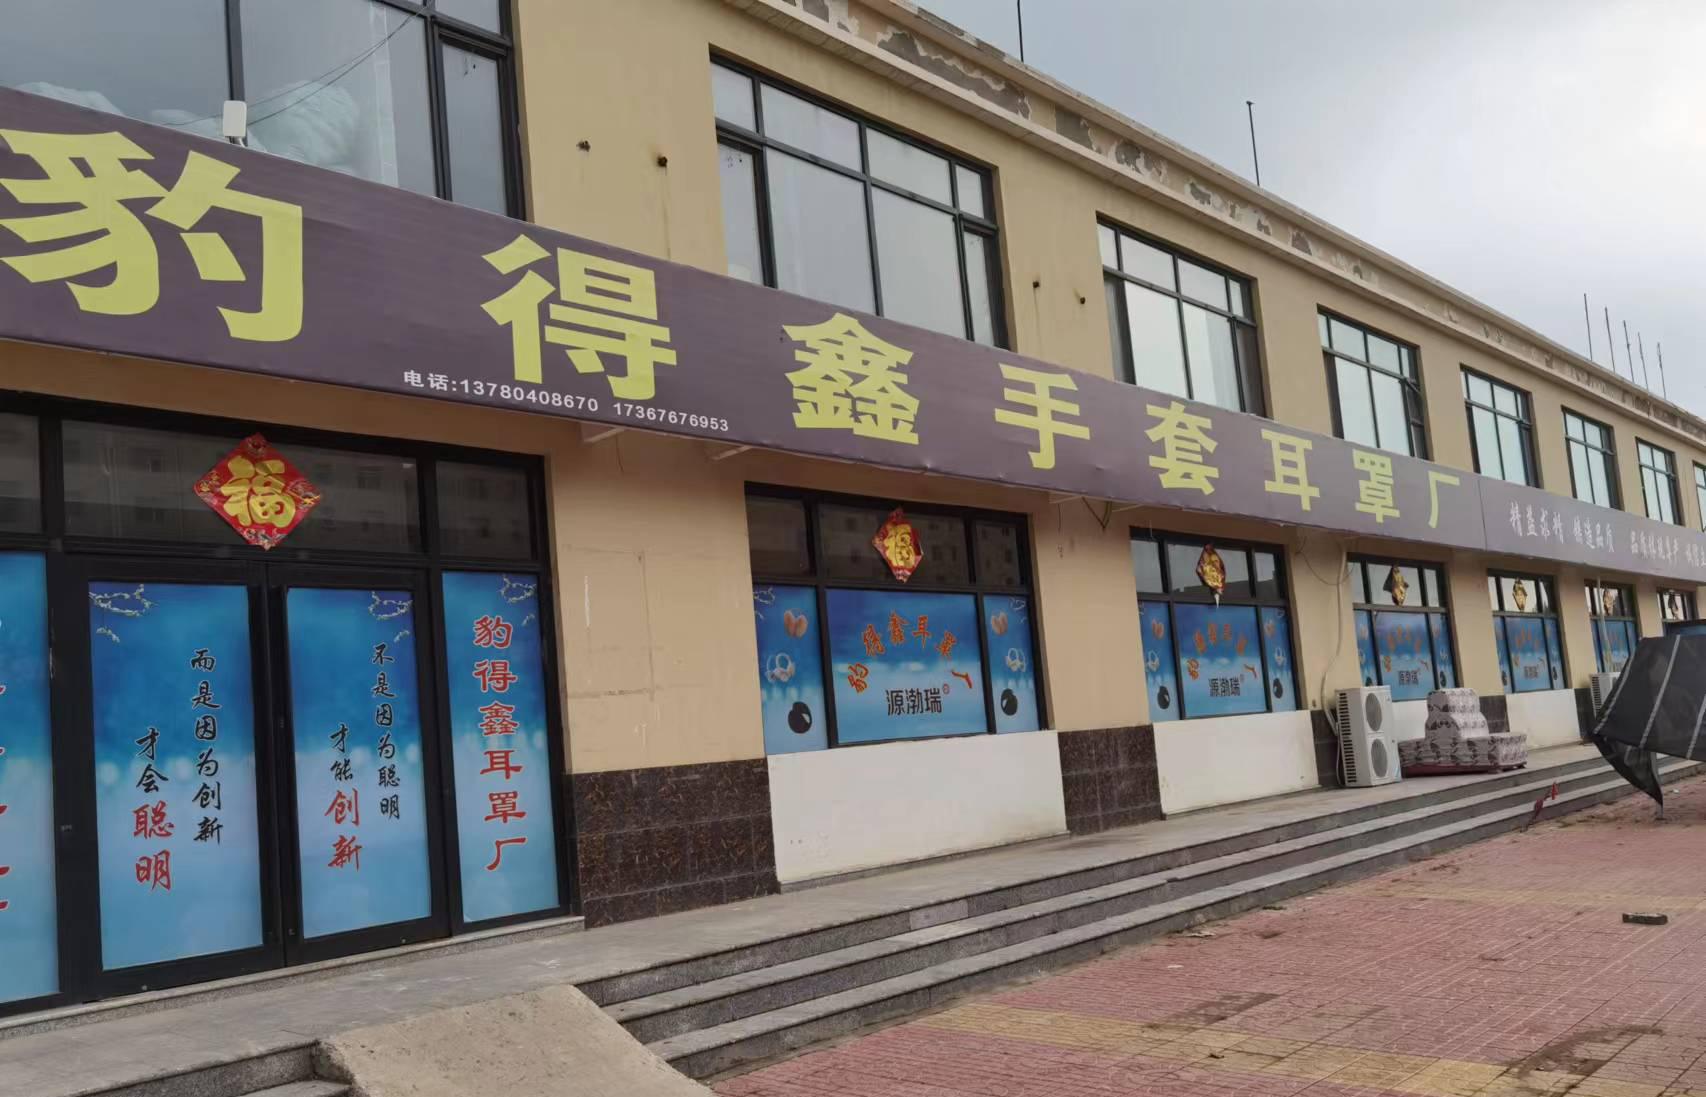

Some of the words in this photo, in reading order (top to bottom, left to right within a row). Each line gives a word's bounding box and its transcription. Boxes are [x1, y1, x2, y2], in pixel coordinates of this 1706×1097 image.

[0, 129, 1462, 528] 豹得鑫手套耳罩厂
[404, 369, 599, 412] 电话:13780408670
[613, 402, 729, 432] 17367676953
[220, 455, 297, 528] 福
[191, 648, 223, 845] 而是因为创新
[372, 642, 400, 821] 不是因为聪明
[472, 615, 526, 872] 豹得鑫耳罩厂
[885, 687, 942, 716] 源渤瑞
[133, 727, 174, 892] 才会聪明
[325, 723, 362, 872] 才能创新
